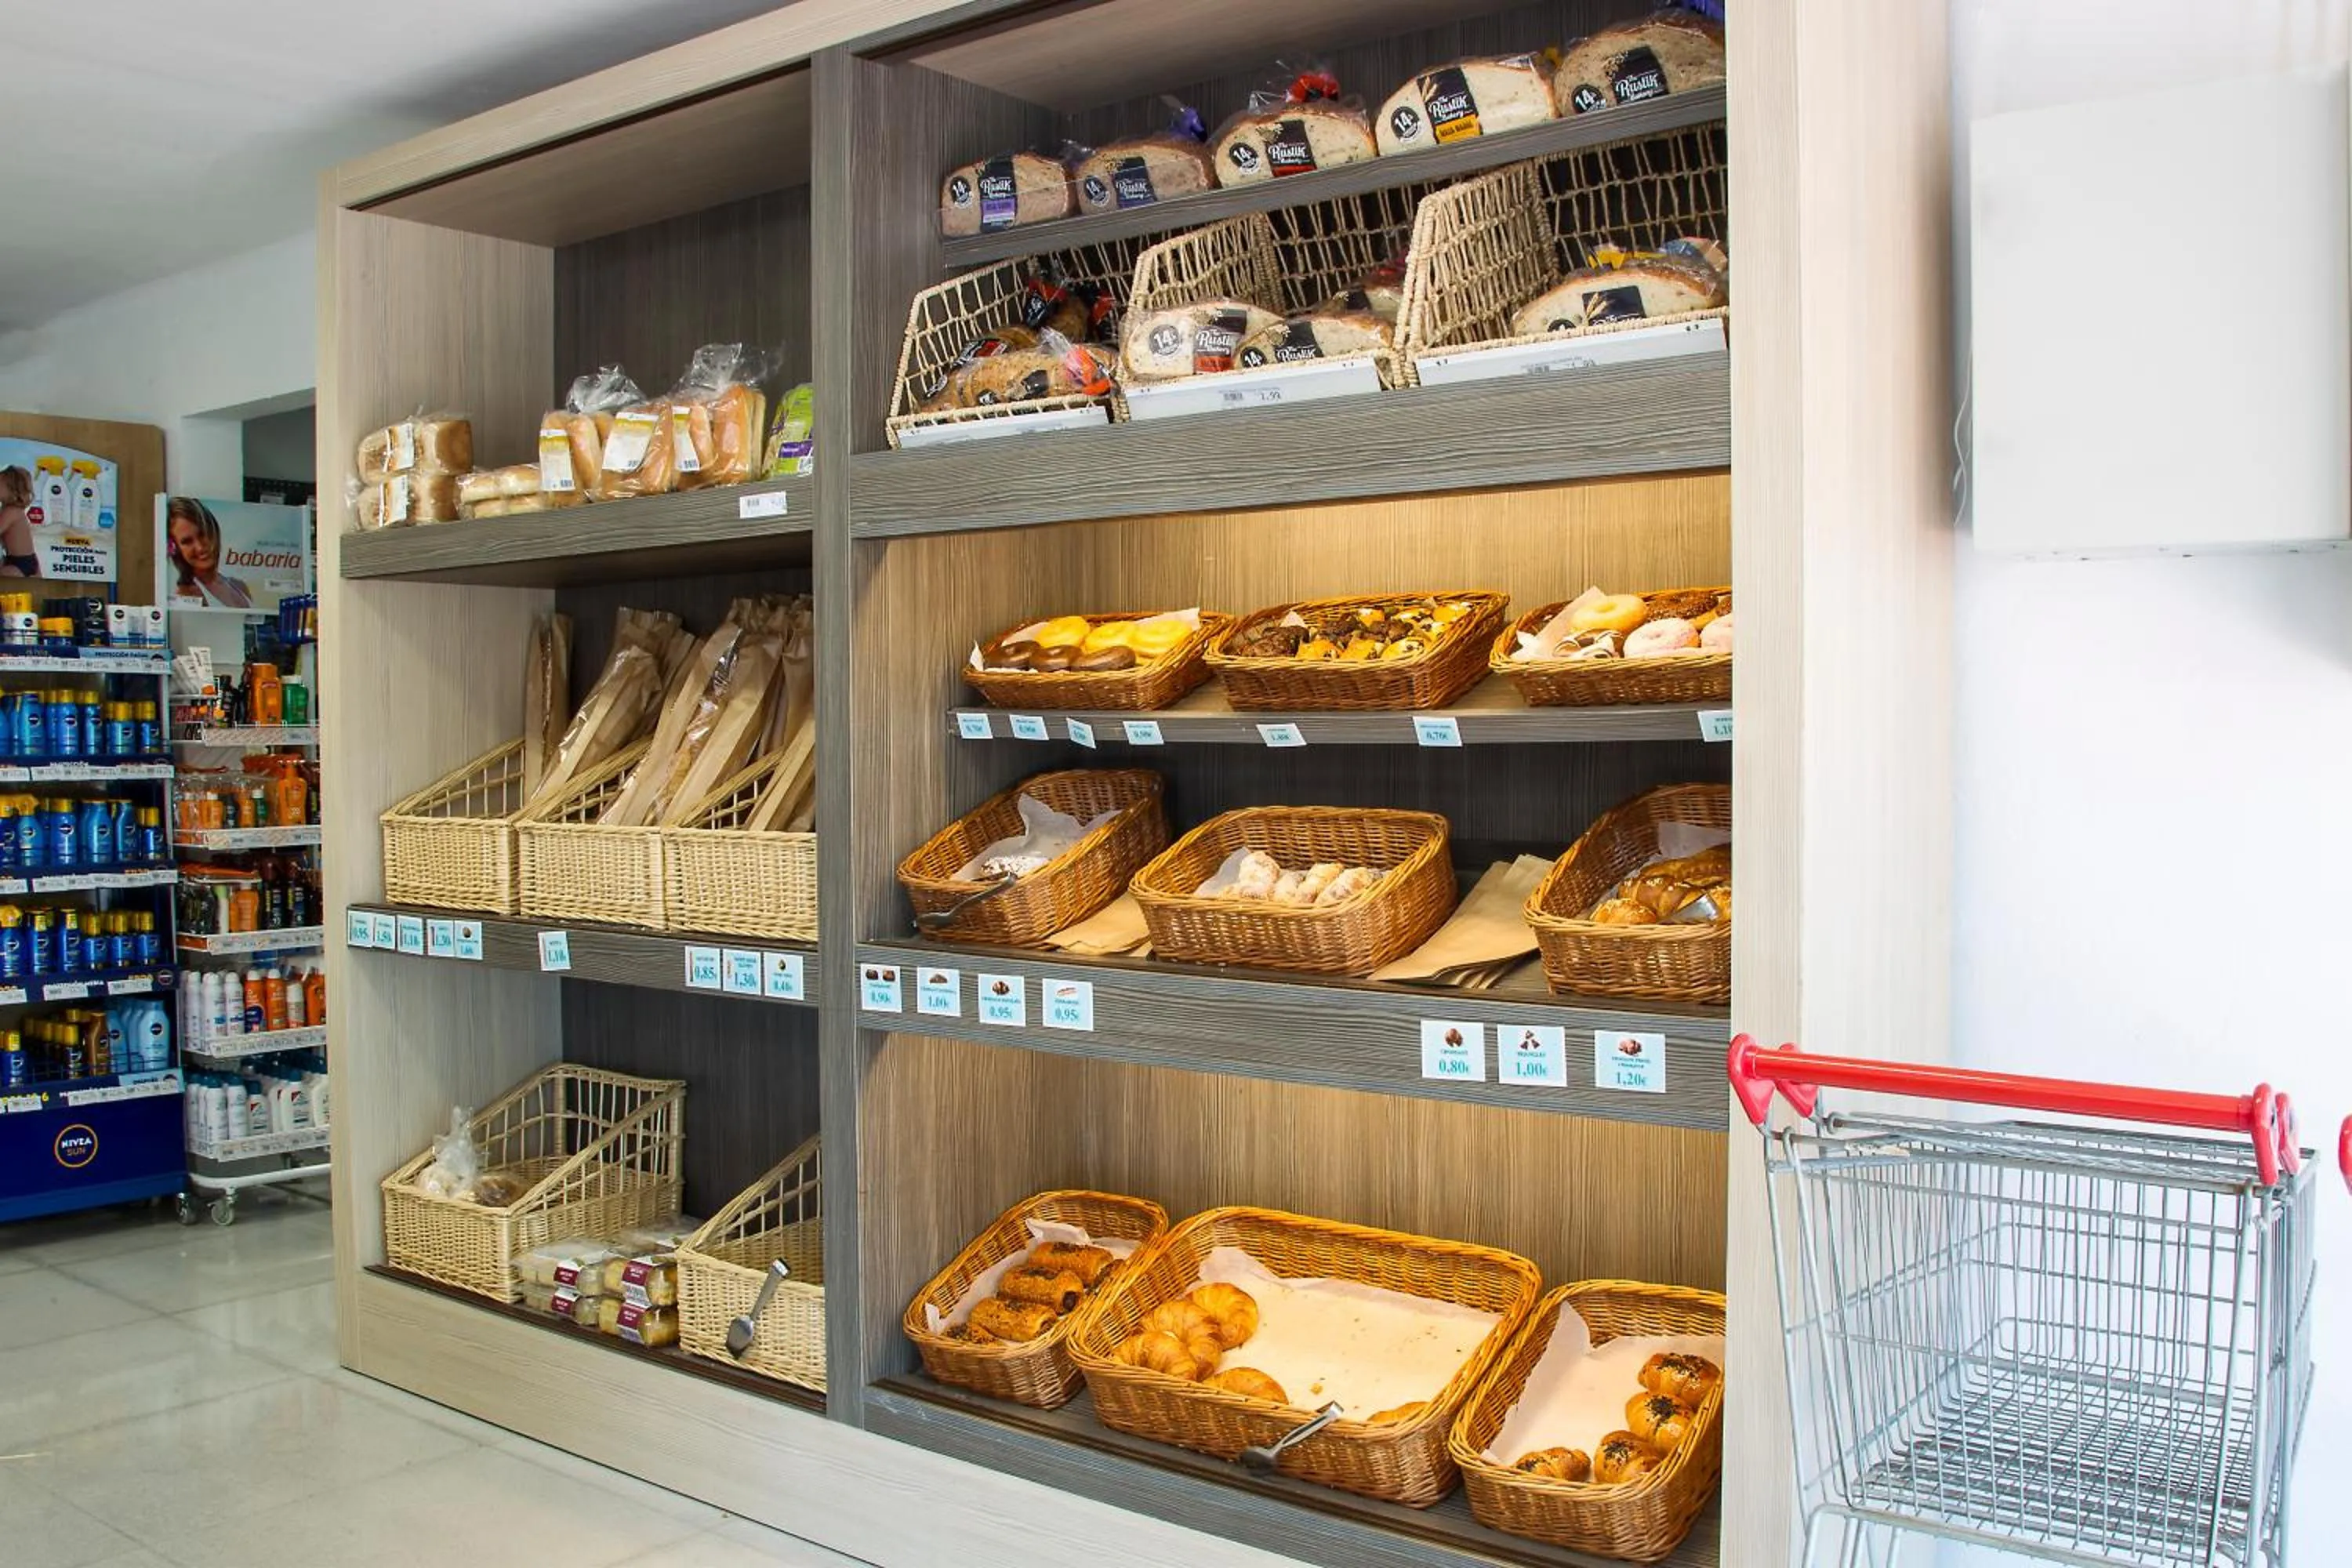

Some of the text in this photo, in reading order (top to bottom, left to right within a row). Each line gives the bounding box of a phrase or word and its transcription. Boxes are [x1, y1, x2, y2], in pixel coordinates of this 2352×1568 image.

[63, 554, 96, 564] PIELES
[225, 547, 301, 568] babaria
[53, 564, 105, 575] SENSIBLES
[61, 1138, 93, 1149] NIVEA
[66, 1148, 86, 1157] SUN
